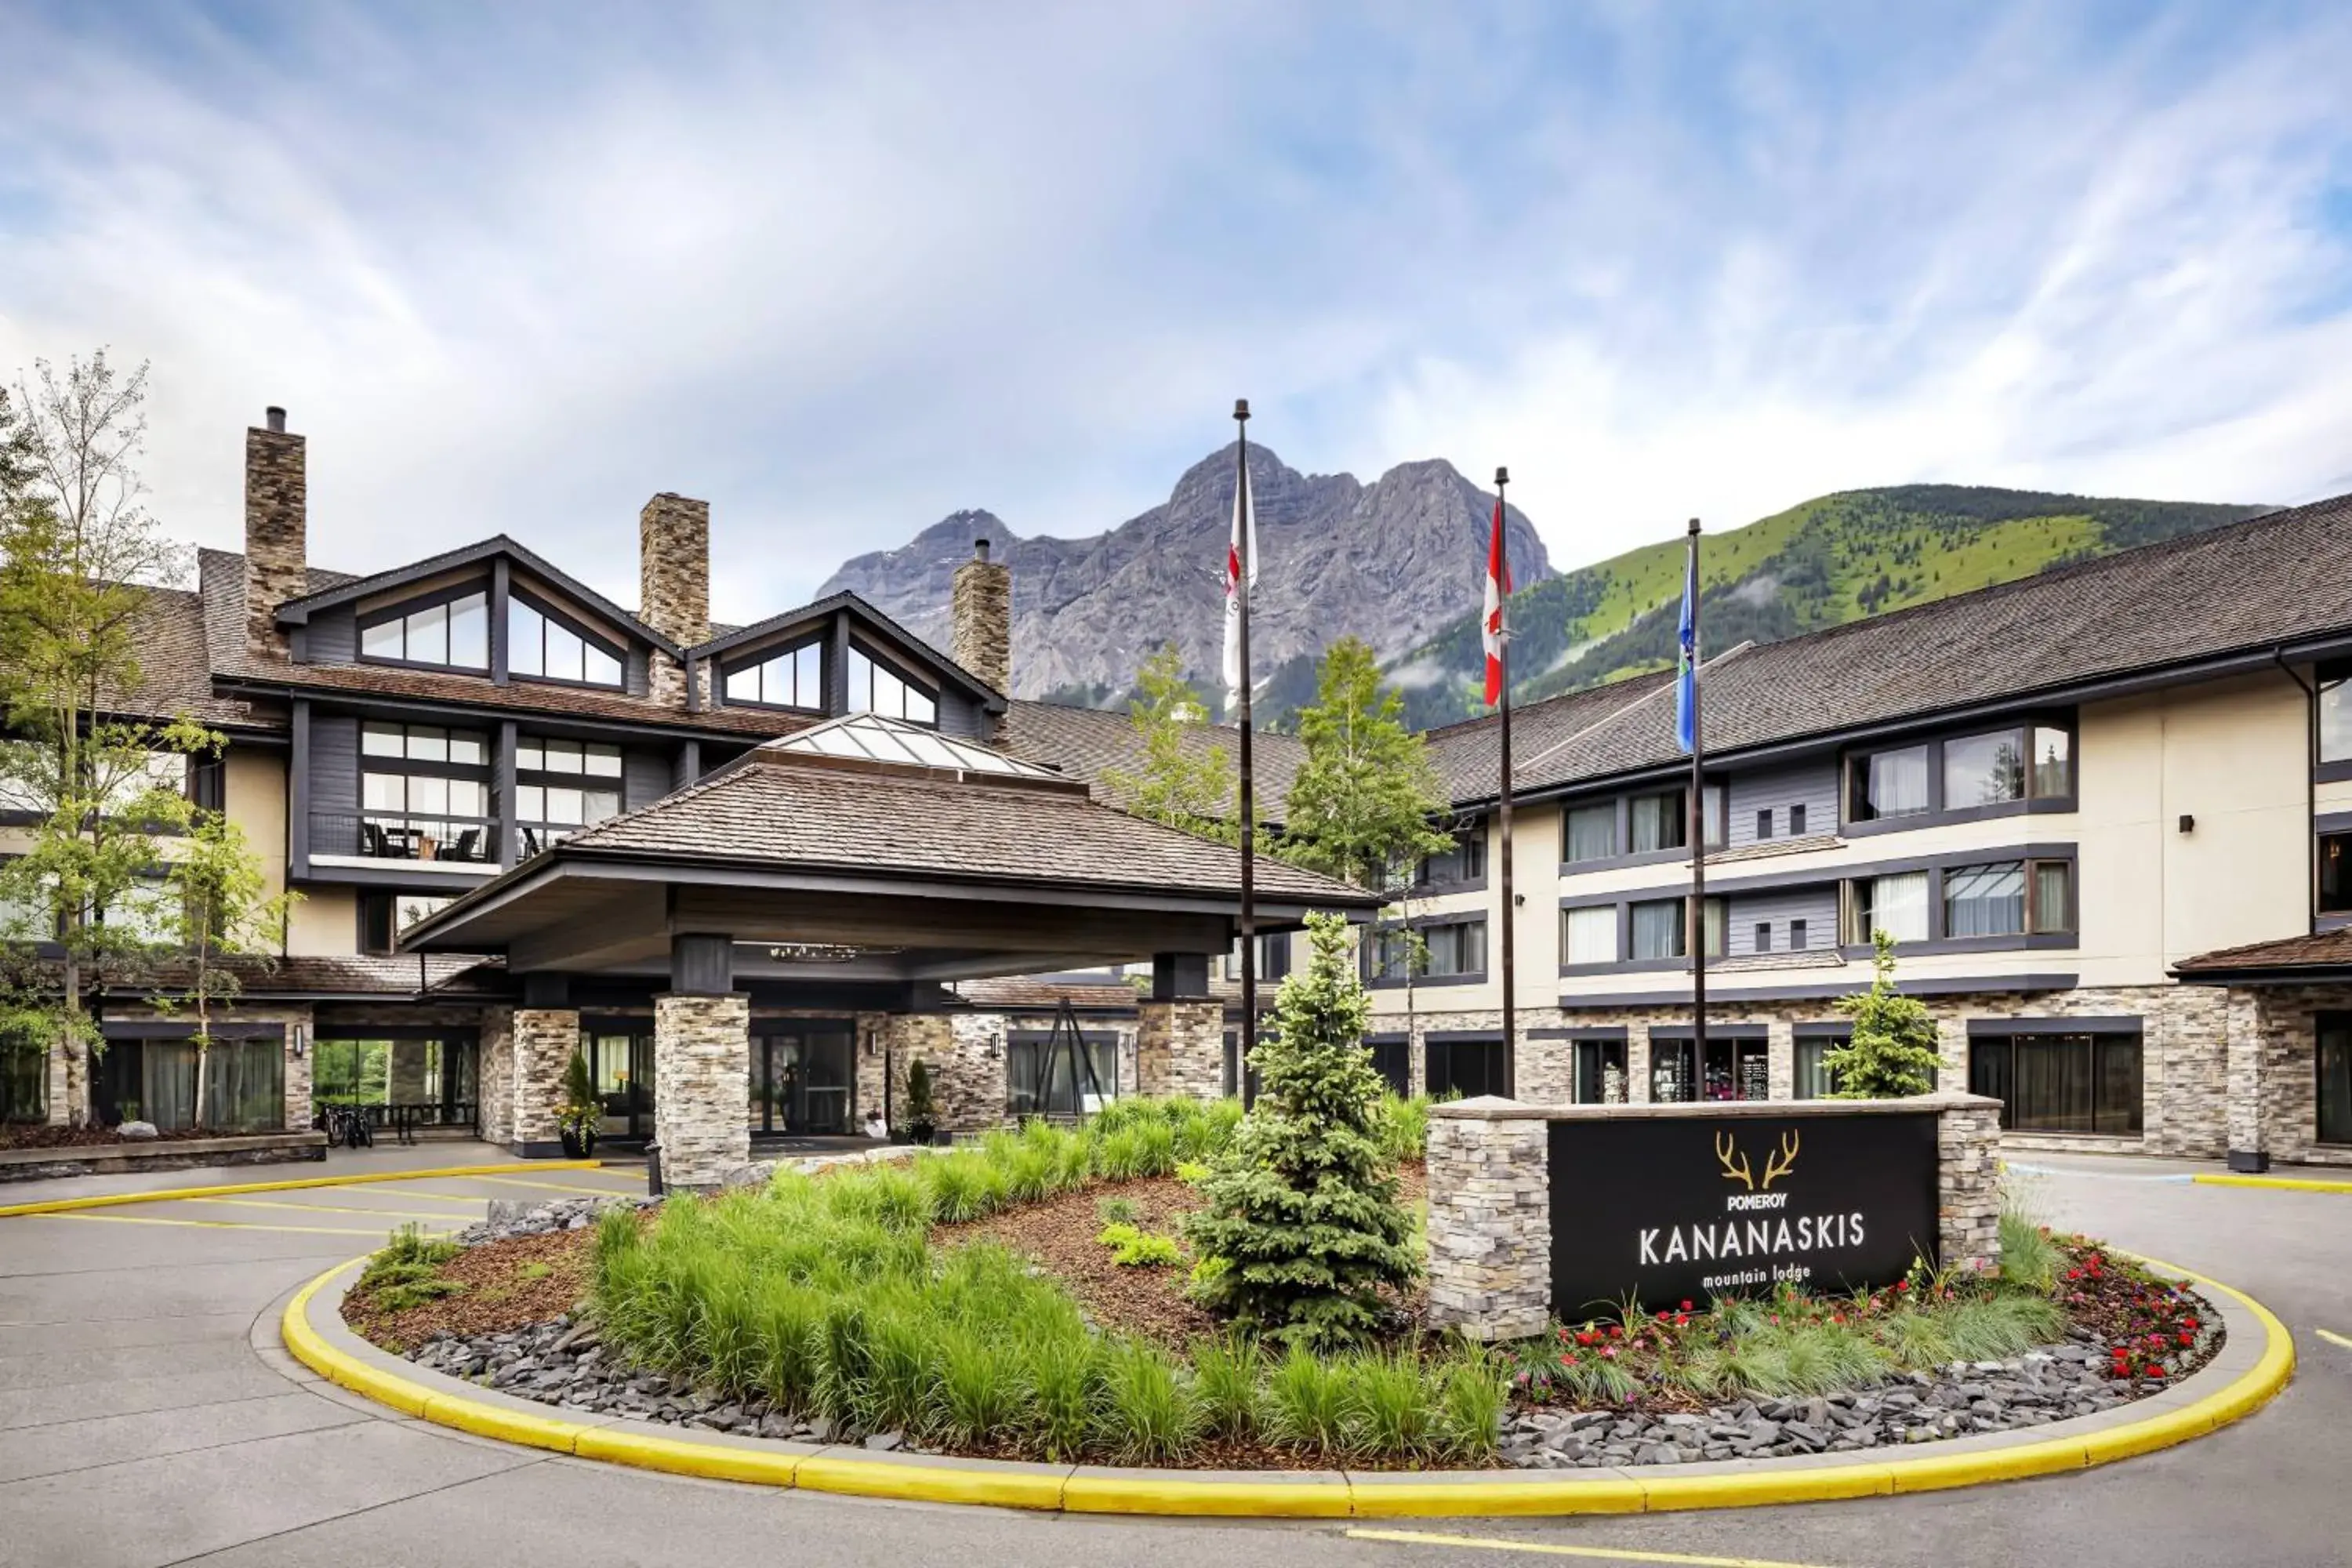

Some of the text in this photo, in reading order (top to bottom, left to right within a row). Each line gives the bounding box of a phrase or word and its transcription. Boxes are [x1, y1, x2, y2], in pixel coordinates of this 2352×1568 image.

[1727, 1192, 1788, 1211] POMEROY
[1640, 1213, 1865, 1265] KANANASKIS
[1703, 1262, 1810, 1288] mountain lodge
